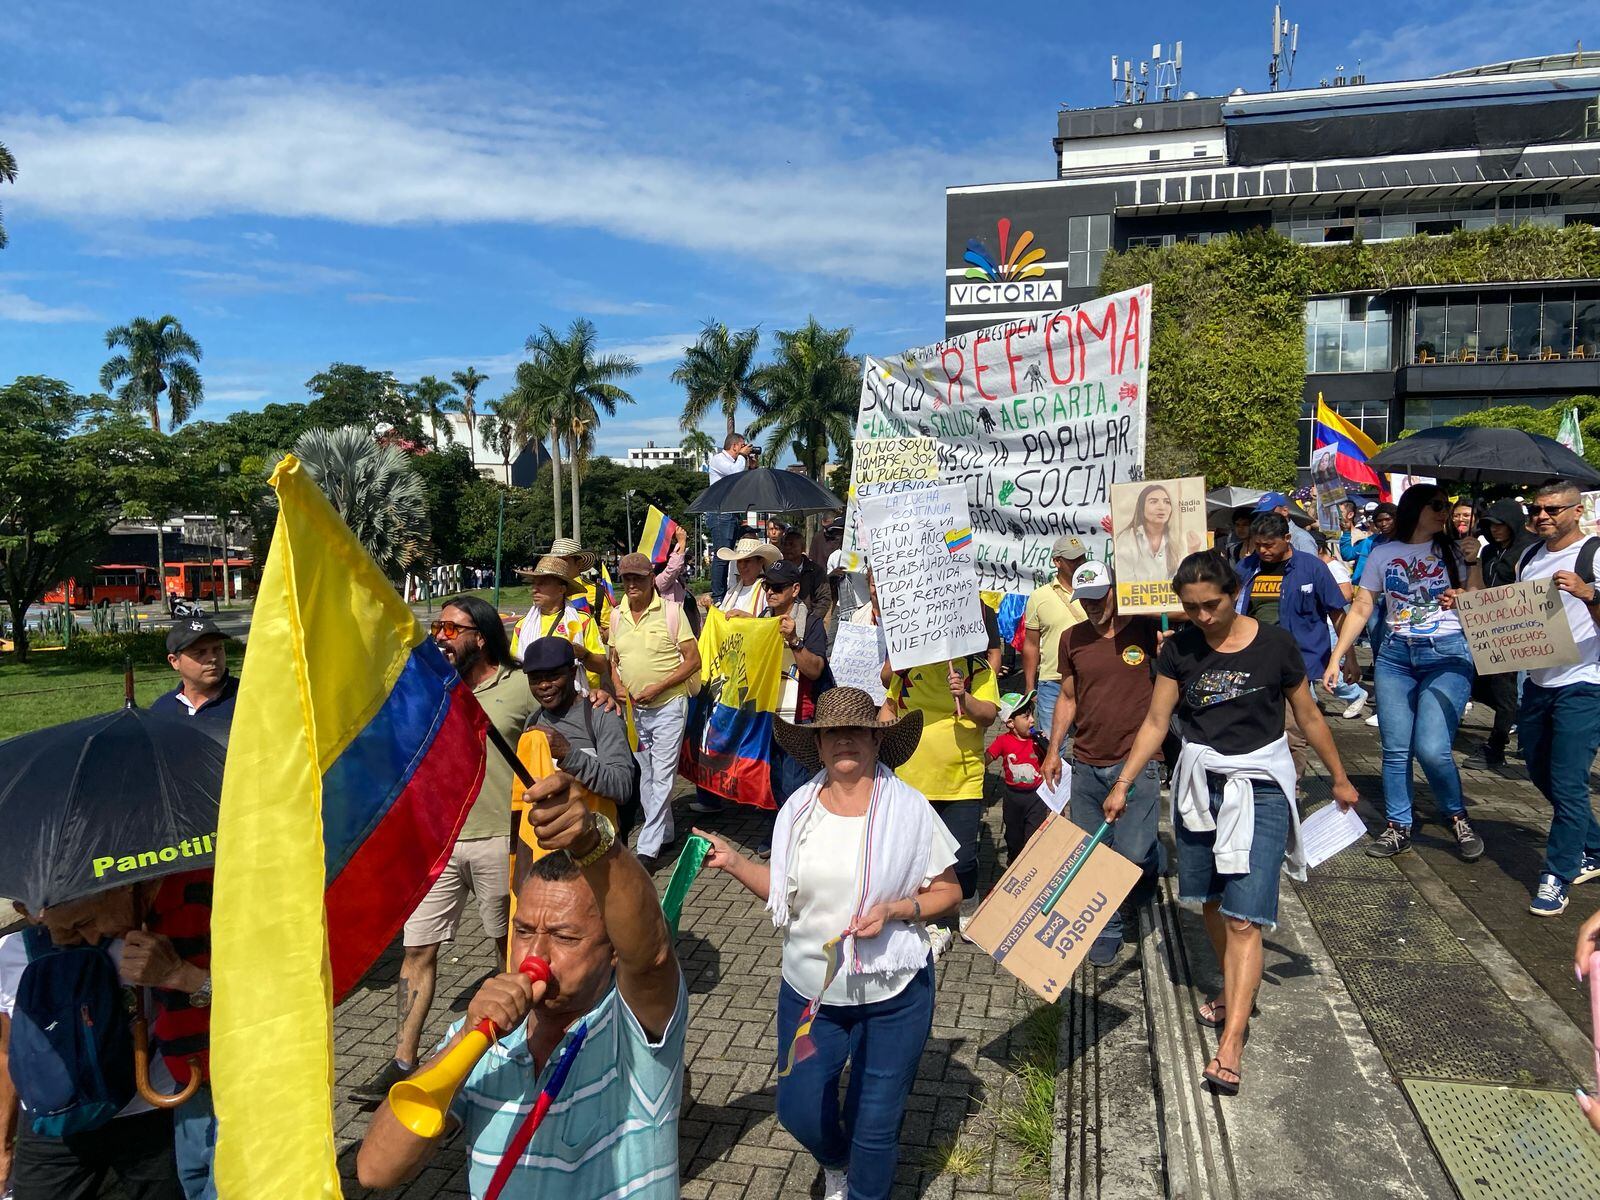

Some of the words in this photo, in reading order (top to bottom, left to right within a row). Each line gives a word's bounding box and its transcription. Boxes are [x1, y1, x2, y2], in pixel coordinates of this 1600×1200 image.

[954, 283, 1058, 303] VICTORIA
[935, 334, 967, 356] PETRO
[855, 441, 872, 457] YO
[875, 439, 896, 454] NO
[899, 438, 922, 456] SOY
[923, 439, 938, 453] UN
[937, 440, 1009, 471] NSULTA
[912, 453, 936, 467] SOY
[856, 470, 874, 484] UN
[857, 484, 872, 497] EL
[885, 494, 899, 508] LA
[904, 489, 939, 506] LUCHA
[891, 502, 952, 520] CONTINUA
[1179, 499, 1200, 507] Nadia
[870, 522, 910, 540] PETRO
[917, 519, 932, 530] SE
[940, 516, 954, 526] VA
[871, 539, 891, 556] EN
[895, 533, 914, 547] UN
[920, 526, 946, 545] AÑO
[873, 543, 943, 568] SEREMOS
[977, 543, 992, 562] DE
[995, 545, 1009, 563] LA
[873, 553, 971, 581] TRABAJADORES
[878, 578, 913, 595] TODA
[916, 572, 933, 588] LA
[1474, 586, 1516, 606] SALUD
[1519, 589, 1527, 603] y
[1532, 580, 1546, 595] la
[881, 593, 906, 611] LAS
[913, 579, 973, 602] REFORMAS
[1121, 594, 1147, 607] DEL
[885, 606, 921, 624] SON
[926, 599, 956, 616] PARA
[1464, 599, 1534, 628] EDUCACIÓN
[1538, 600, 1554, 612] no
[886, 619, 920, 638] TUS
[1471, 629, 1489, 641] son
[891, 627, 948, 654] NIETOS
[1473, 641, 1491, 652] son
[1493, 630, 1547, 648] DERECHOS
[1489, 648, 1506, 664] del
[1510, 643, 1554, 661] PUEBLO
[1050, 843, 1086, 888] ESPIRALES
[1000, 887, 1054, 953] MULTIMATERIAS
[1055, 892, 1108, 960] master
